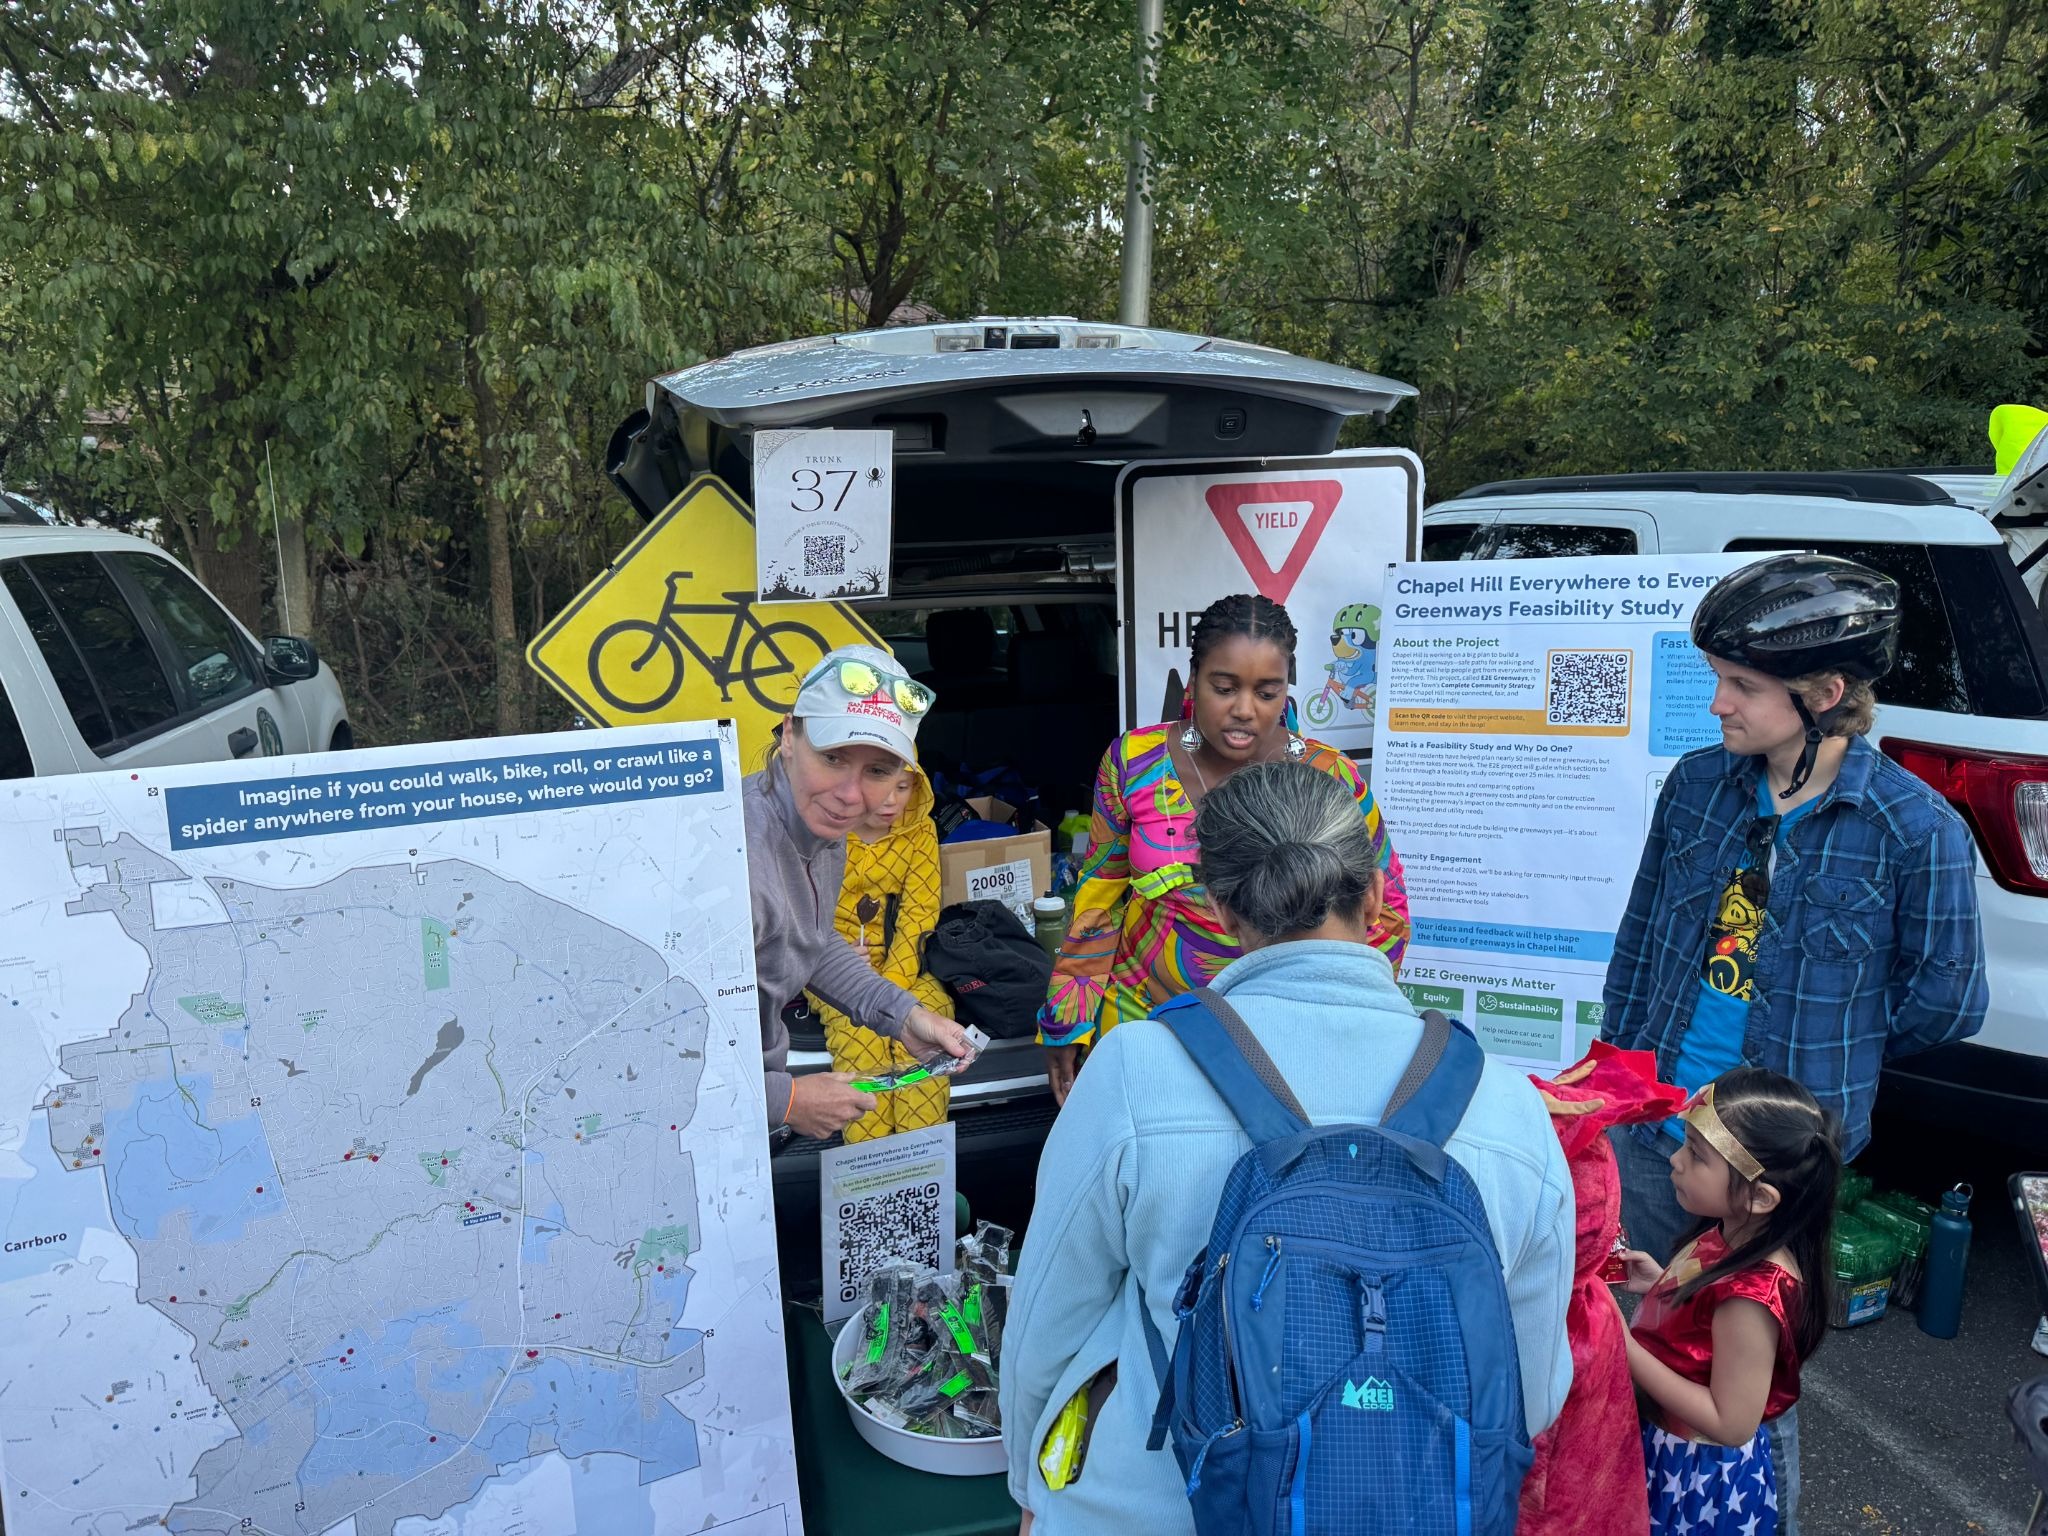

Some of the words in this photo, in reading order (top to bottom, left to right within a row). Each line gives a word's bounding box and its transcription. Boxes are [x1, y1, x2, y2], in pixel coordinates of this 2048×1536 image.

[791, 469, 858, 512] 37
[1255, 512, 1298, 528] YIELD
[1398, 578, 1464, 597] Chapel
[1471, 576, 1502, 592] Hill
[1510, 574, 1630, 594] Everywhere
[1638, 575, 1659, 588] to
[1396, 604, 1502, 620] Greenways
[1510, 600, 1614, 619] Feasibility
[1622, 599, 1684, 619] Study
[1393, 638, 1429, 647] About
[1433, 638, 1452, 647] the
[1456, 637, 1499, 649] Project
[1661, 638, 1688, 648] Fast
[847, 707, 902, 726] MARATHON
[865, 704, 901, 719] FRANCISCO
[1427, 742, 1467, 751] Feasibility
[1470, 743, 1494, 752] Study
[1514, 744, 1533, 753] Why
[240, 785, 322, 805] Imagine
[328, 781, 341, 797] if
[347, 782, 384, 799] you
[390, 772, 443, 790] could
[449, 767, 498, 784] walk,
[503, 764, 547, 779] bike,
[554, 759, 588, 774] roll,
[594, 759, 612, 770] or
[617, 751, 663, 768] crawl
[669, 749, 698, 763] like
[703, 750, 712, 760] a
[182, 818, 247, 840] spider
[255, 809, 354, 830] anywhere
[360, 803, 405, 818] from
[412, 798, 455, 816] your
[461, 792, 522, 807] house,
[528, 785, 584, 800] where
[589, 776, 642, 794] would
[648, 776, 678, 791] you
[684, 768, 713, 788] go?
[1397, 853, 1428, 862] munity
[1431, 854, 1481, 864] Engagement
[972, 872, 1014, 891] 20080
[1435, 924, 1456, 932] ideas
[1476, 927, 1513, 937] feedback
[1534, 932, 1552, 942] help
[1554, 934, 1580, 943] shape
[1433, 934, 1458, 943] future
[1470, 939, 1515, 949] greenways
[1527, 943, 1556, 952] Chapel
[1415, 968, 1436, 979] E2E
[1440, 970, 1507, 988] Greenways
[1512, 977, 1555, 990] Matter
[718, 984, 756, 997] Durham
[1424, 993, 1450, 1004] Equity
[1499, 1001, 1558, 1015] Sustainability
[836, 1157, 856, 1166] Chapel
[869, 1149, 901, 1159] Everywhere
[910, 1139, 942, 1150] Everywhere
[850, 1160, 881, 1170] Greenways
[883, 1154, 911, 1163] Feasibility
[4, 1232, 67, 1253] Carrboro
[1362, 1388, 1393, 1403] REI
